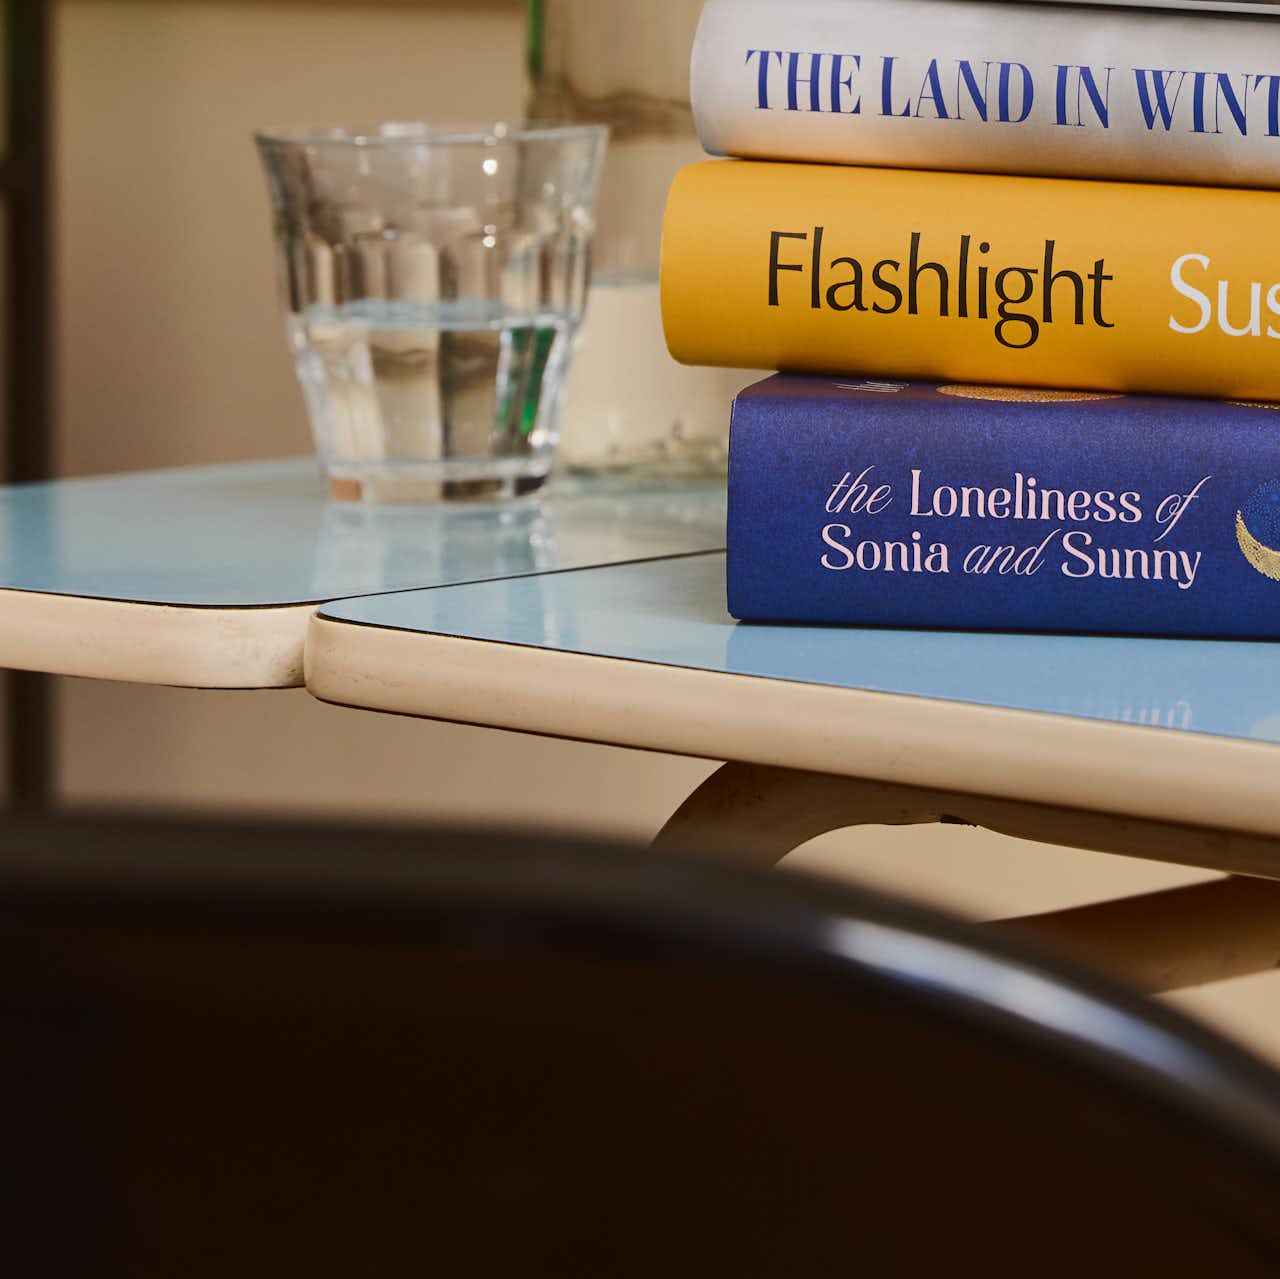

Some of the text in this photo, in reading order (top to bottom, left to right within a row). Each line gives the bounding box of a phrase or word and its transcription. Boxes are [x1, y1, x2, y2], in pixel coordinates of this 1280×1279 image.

[746, 49, 862, 114] THE
[878, 55, 1035, 123] LAND
[1051, 64, 1116, 129] IN
[767, 226, 1115, 349] Flashlight
[825, 465, 1213, 543] the Loneliness of
[820, 523, 1202, 590] Sonia and Sunny
